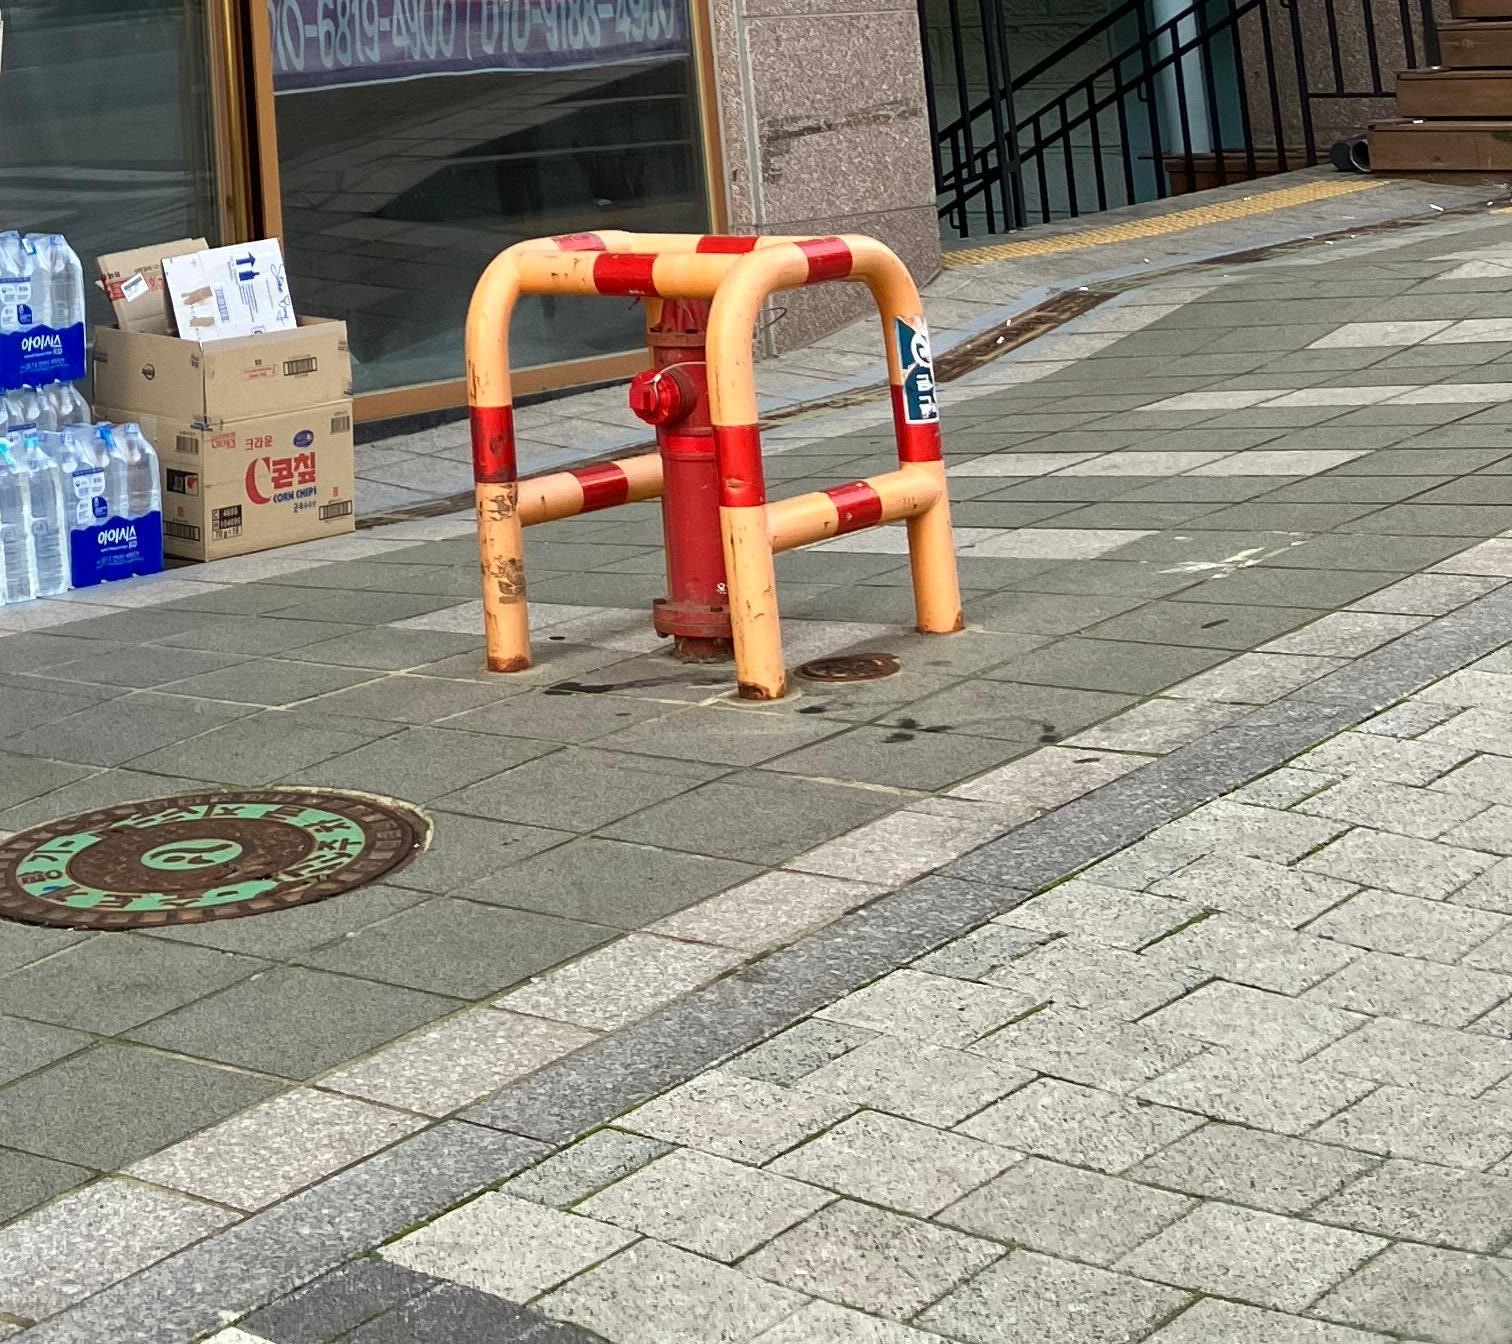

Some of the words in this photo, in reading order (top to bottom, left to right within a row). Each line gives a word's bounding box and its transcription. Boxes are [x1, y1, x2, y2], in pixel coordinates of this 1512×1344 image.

[21, 334, 63, 353] 아이시스
[245, 434, 273, 451] 크라운
[97, 524, 138, 546] 아이시스
